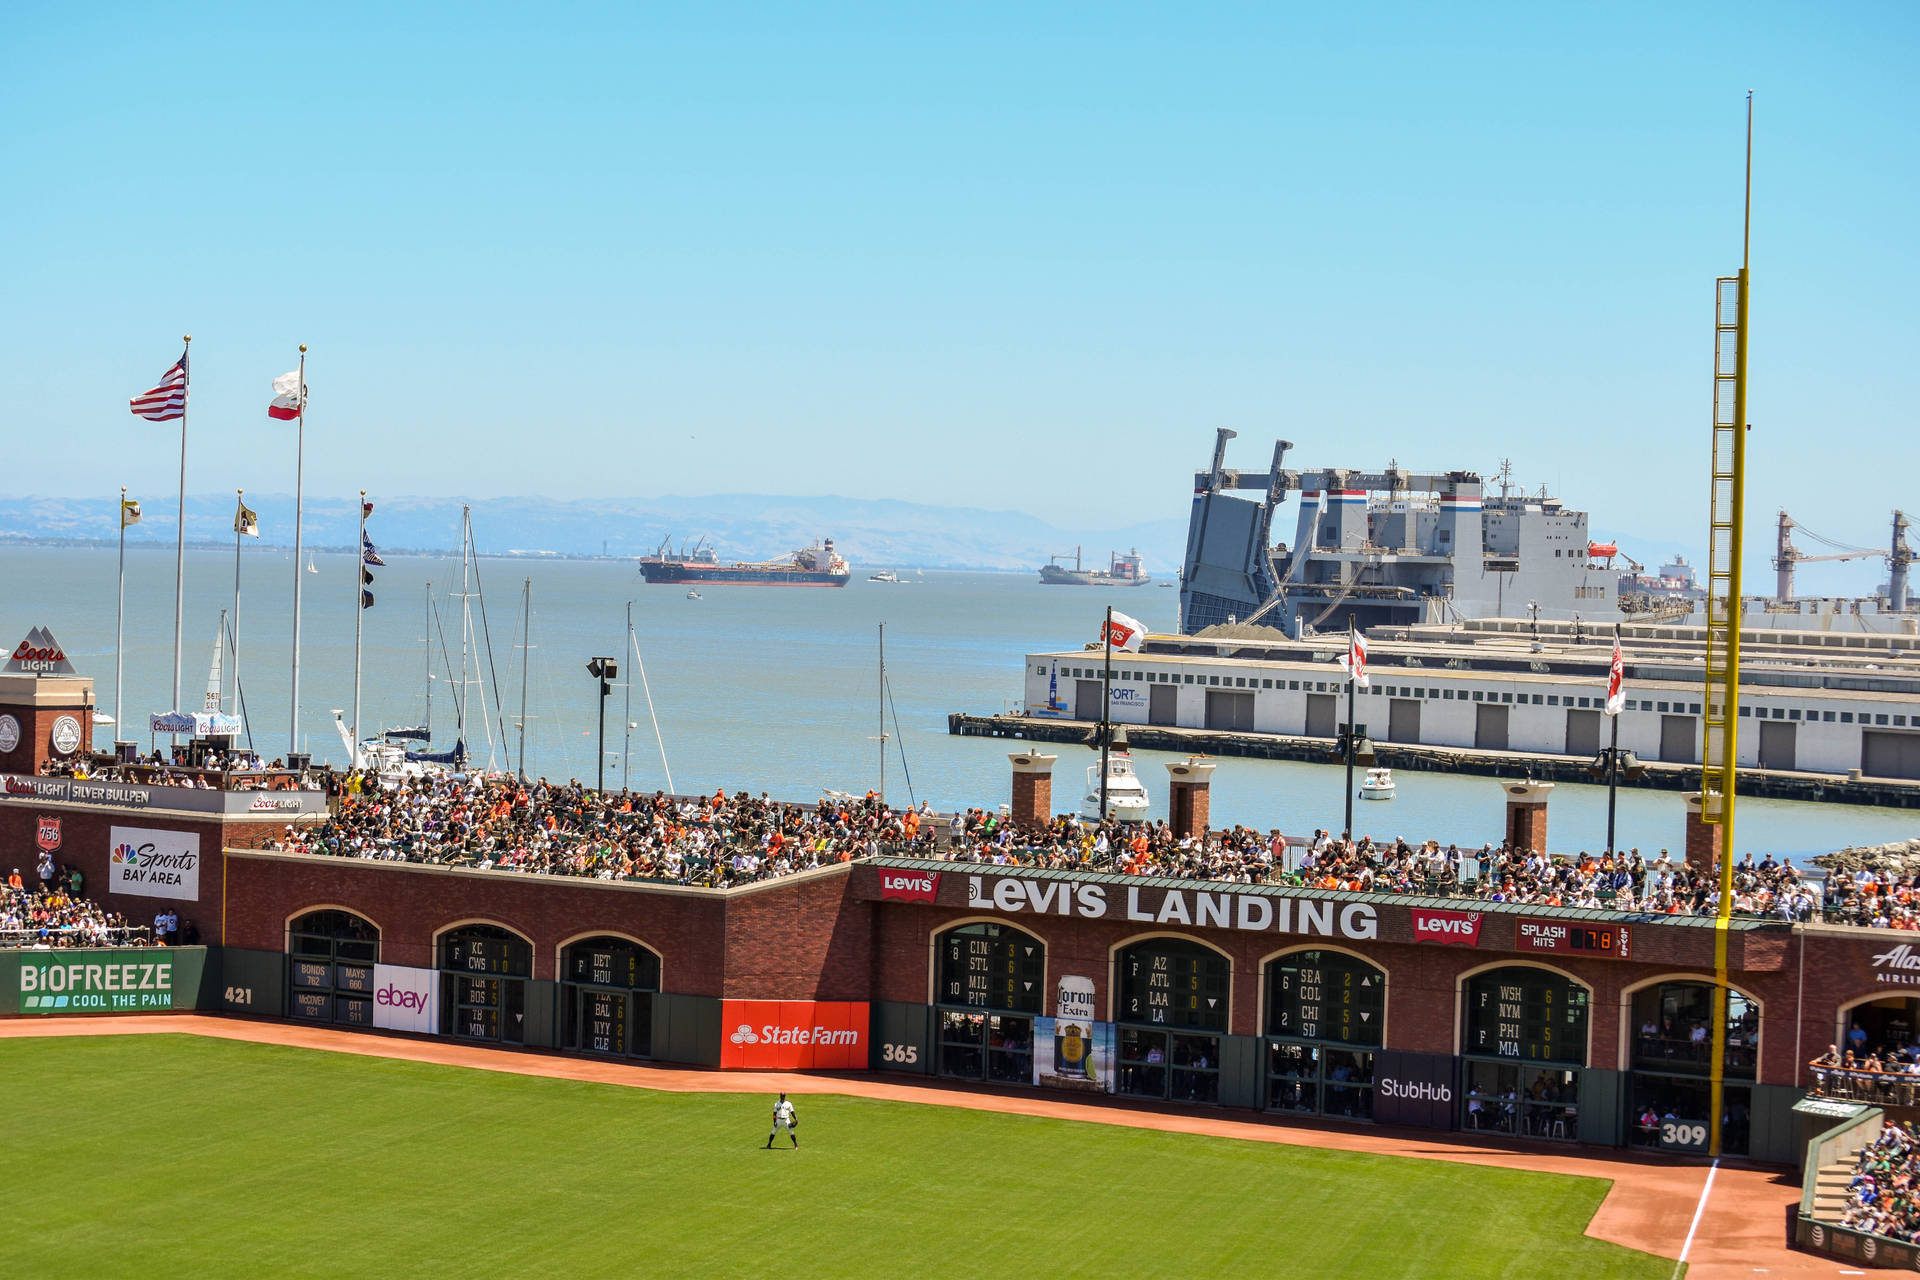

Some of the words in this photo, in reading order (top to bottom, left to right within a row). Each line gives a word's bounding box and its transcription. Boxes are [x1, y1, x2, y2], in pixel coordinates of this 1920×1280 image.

[12, 640, 65, 661] Coors
[21, 660, 56, 671] LIGHT
[175, 723, 193, 733] LIGHT
[221, 725, 240, 734] LIGHT
[37, 782, 66, 796] LIGHT
[72, 785, 105, 799] SILVER
[106, 788, 150, 803] BULLPEN
[280, 800, 303, 809] LIGHT
[40, 827, 59, 842] 756
[137, 843, 197, 873] Sports
[122, 868, 147, 882] BAY
[148, 871, 182, 886] AREA
[1127, 886, 1378, 940] LANDING
[1521, 924, 1566, 939] SPLASH
[1533, 936, 1555, 948] HITS
[1587, 930, 1611, 949] 78
[454, 947, 460, 960] F
[471, 941, 483, 955] KC
[952, 946, 959, 960] 8
[970, 940, 988, 955] CIN
[1008, 944, 1015, 958] 3
[468, 956, 486, 971] CWS
[578, 960, 584, 973] F
[593, 954, 611, 968] DET
[970, 957, 988, 972] STL
[1008, 960, 1014, 974] 6
[1153, 956, 1167, 970] AZ
[1192, 960, 1197, 973] 1
[301, 964, 326, 976] BONDS
[345, 968, 366, 980] MAYS
[1132, 962, 1139, 976] F
[307, 976, 320, 986] 762
[349, 979, 362, 990] 660
[593, 970, 611, 984] HOU
[968, 975, 987, 990] MIL
[1008, 978, 1014, 992] 6
[1149, 973, 1170, 988] ATL
[1192, 976, 1197, 990] 5
[1282, 976, 1289, 990] 6
[1300, 968, 1321, 984] SEA
[1344, 972, 1351, 986] 2
[225, 986, 252, 1004] 421
[950, 982, 960, 995] 10
[1300, 986, 1321, 1001] COL
[1344, 990, 1350, 1004] 2
[1500, 986, 1522, 1002] WSH
[1546, 990, 1552, 1004] 6
[72, 996, 107, 1006] COOL
[112, 995, 137, 1006] THE
[142, 994, 172, 1006] PAIN
[376, 982, 428, 1014] ebay
[469, 990, 486, 1004] BOS
[968, 991, 987, 1006] PIT
[1008, 995, 1014, 1009] 5
[1149, 991, 1169, 1006] LAA
[1190, 995, 1197, 1008] 0
[1481, 993, 1488, 1007] F
[306, 1006, 318, 1016] 521
[348, 1000, 362, 1012] OTT
[595, 1003, 611, 1018] BAL
[1062, 1004, 1088, 1017] Extra
[1132, 998, 1138, 1012] 2
[1499, 1003, 1520, 1018] NYM
[1546, 1008, 1550, 1022] 1
[1152, 1008, 1164, 1023] LA
[1282, 1012, 1288, 1026] 2
[1301, 1005, 1319, 1020] CHI
[1344, 1009, 1350, 1023] 5
[469, 1022, 485, 1036] MIN
[594, 1020, 611, 1035] NYY
[1302, 1022, 1316, 1038] SD
[1342, 1026, 1349, 1040] 0
[1499, 1022, 1520, 1038] PHI
[1544, 1027, 1551, 1041] 5
[594, 1036, 609, 1051] CLE
[1480, 1030, 1486, 1044] F
[882, 1043, 918, 1064] 365
[1498, 1040, 1520, 1056] MIA
[1381, 1078, 1452, 1102] StubHub
[1662, 1123, 1706, 1145] 309
